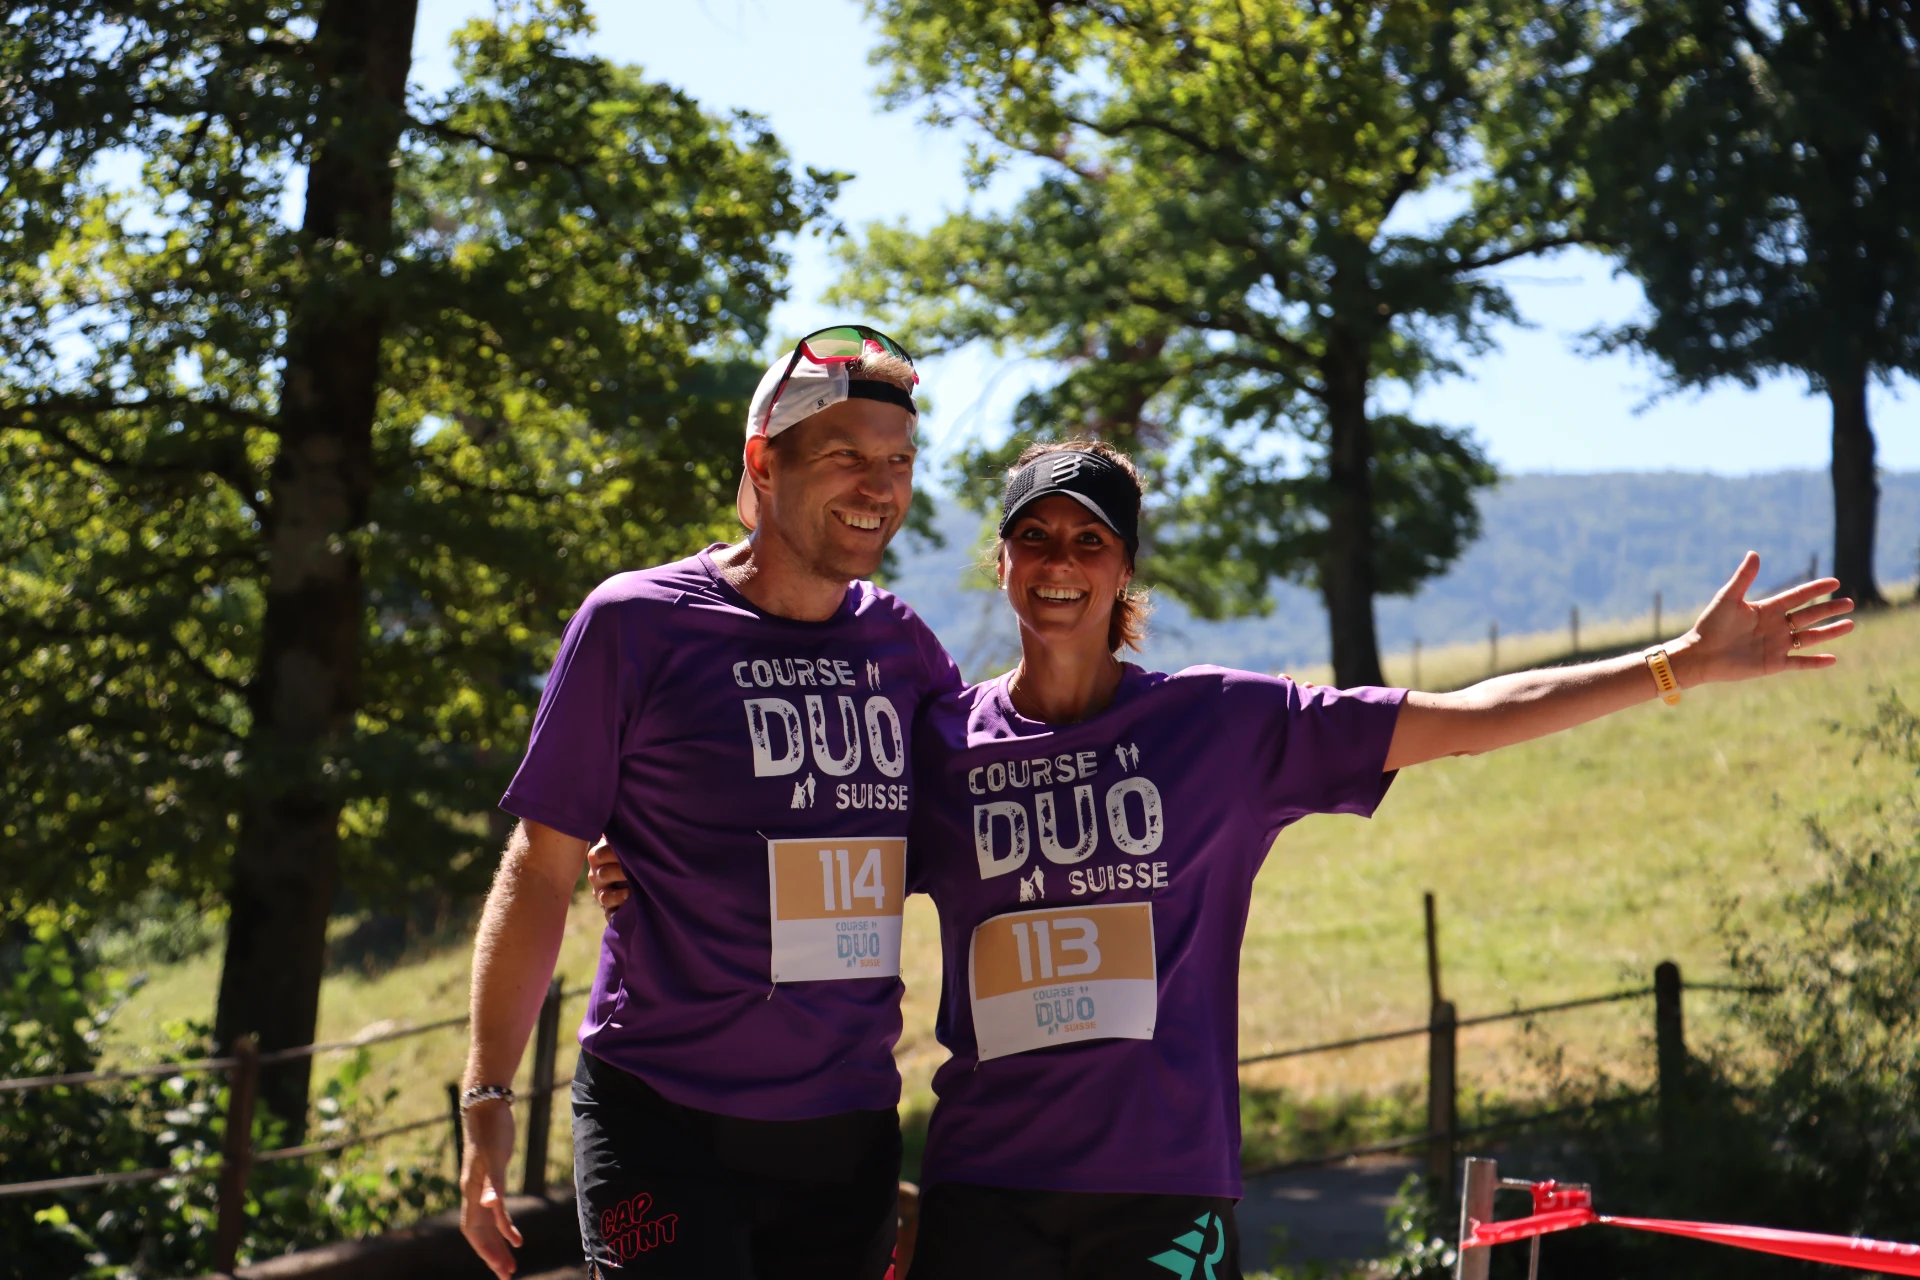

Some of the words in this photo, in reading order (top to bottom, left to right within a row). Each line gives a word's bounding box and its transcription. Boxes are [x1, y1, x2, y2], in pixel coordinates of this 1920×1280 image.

[732, 658, 856, 687] COURSE
[744, 695, 905, 778] DUO
[968, 751, 1098, 795] COURSE
[835, 783, 909, 811] SUISSE
[973, 776, 1164, 880] DUO
[818, 848, 885, 911] 114
[1068, 861, 1169, 896] SUISSE
[835, 921, 869, 931] COURSE
[837, 932, 880, 959] DUO
[1011, 917, 1102, 983] 113
[860, 958, 881, 967] SUISSE
[1032, 986, 1075, 1001] COURSE
[1035, 996, 1095, 1027] DUO
[1064, 1021, 1097, 1033] SUISSE
[601, 1192, 652, 1239] CAP
